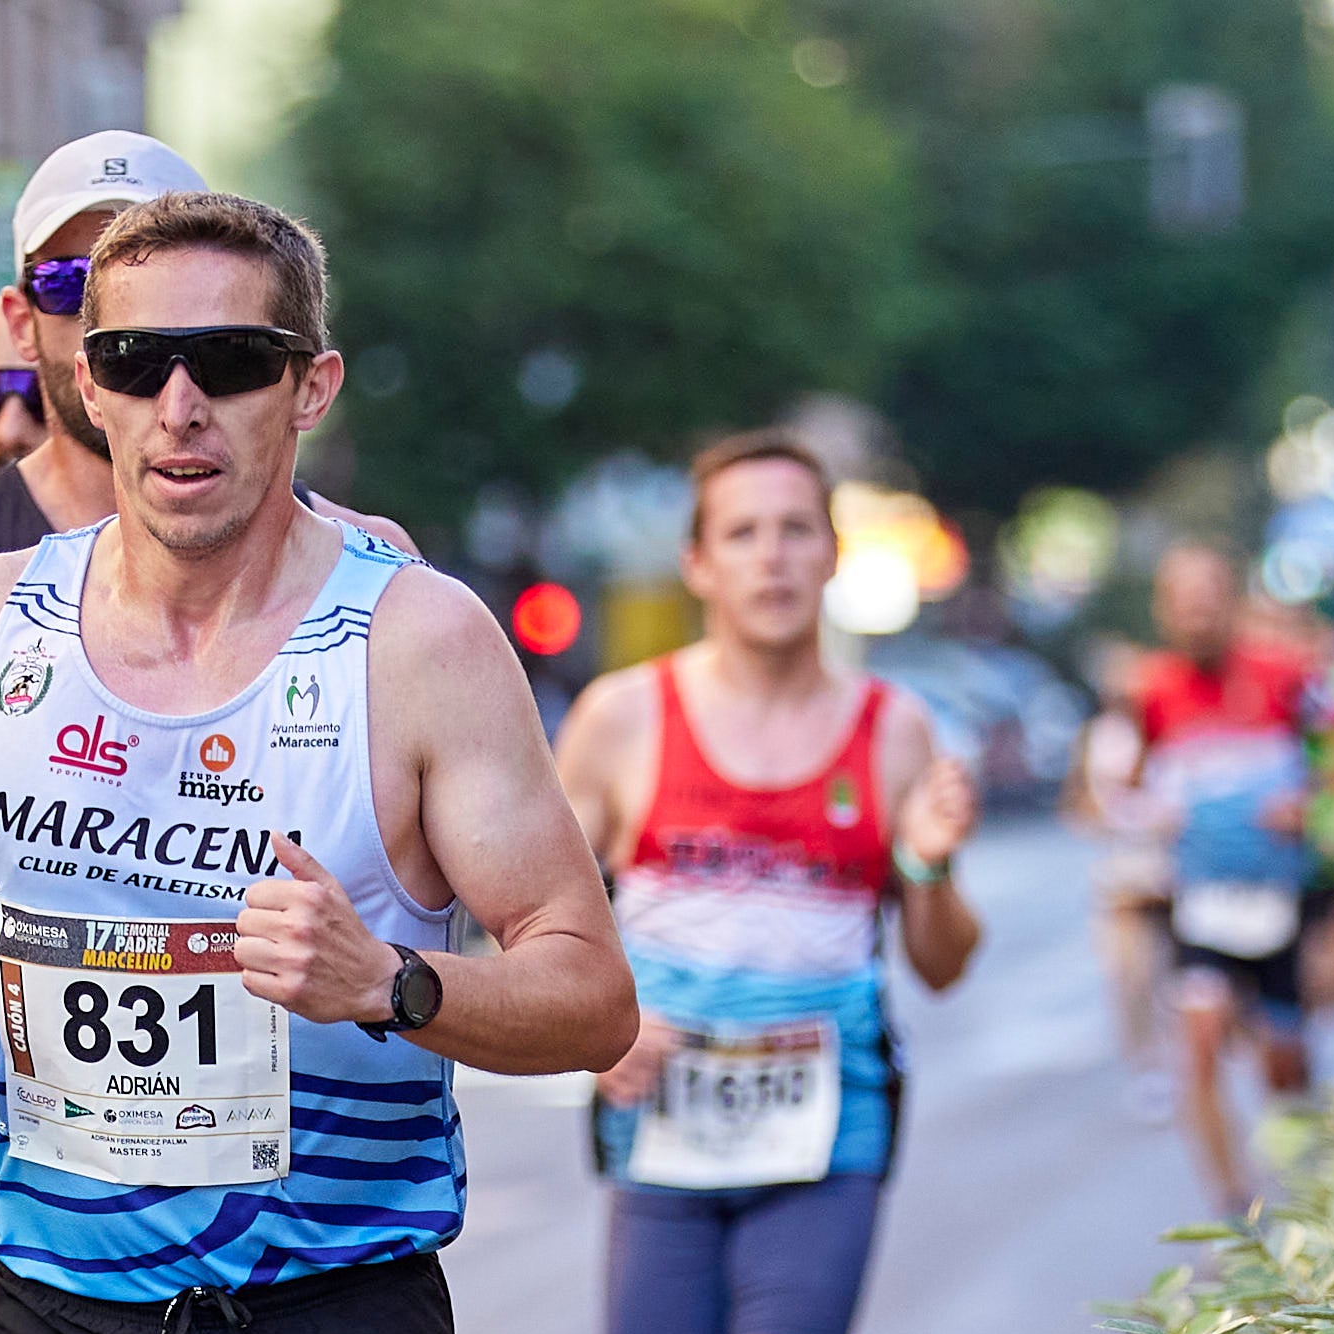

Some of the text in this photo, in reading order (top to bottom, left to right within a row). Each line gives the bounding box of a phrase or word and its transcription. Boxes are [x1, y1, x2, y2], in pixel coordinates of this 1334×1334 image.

[271, 723, 341, 735] Ayuntamiento
[279, 736, 340, 748] Maracena
[50, 767, 122, 787] sport shop
[180, 771, 221, 782] grupo
[178, 779, 264, 806] mayfo
[18, 856, 246, 901] CLUB DE ATLETISM
[16, 920, 68, 939] OXIMESA
[86, 921, 170, 951] 17 MEMORIAL
[115, 936, 166, 953] PADRE
[82, 949, 172, 971] MARCELINO
[8, 983, 27, 1052] CAJÓN 4
[63, 980, 216, 1067] 831
[106, 1072, 180, 1096] ADRIÁN
[20, 1090, 57, 1107] CALERO
[118, 1110, 163, 1118] OXIMESA
[227, 1108, 275, 1122] ANAYA
[109, 1147, 162, 1157] MASTER 35
